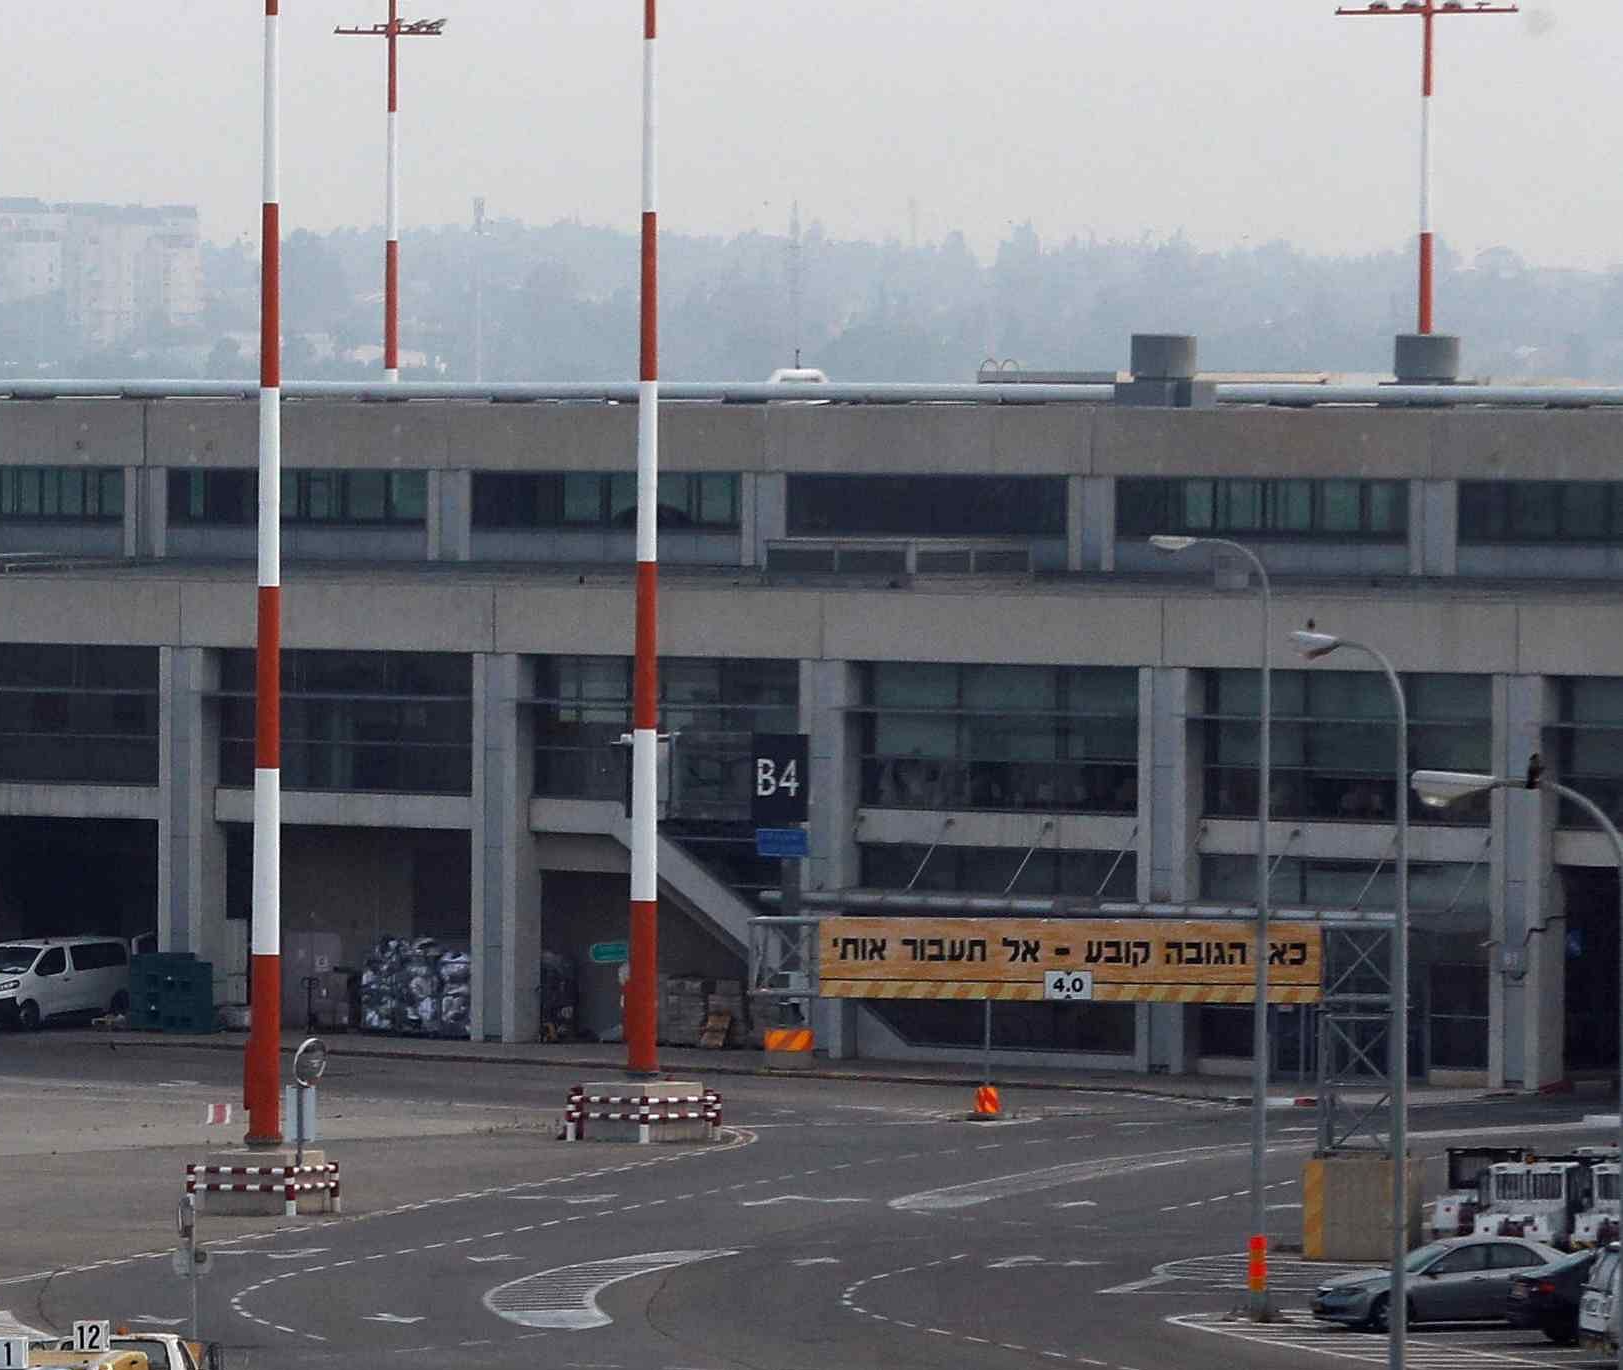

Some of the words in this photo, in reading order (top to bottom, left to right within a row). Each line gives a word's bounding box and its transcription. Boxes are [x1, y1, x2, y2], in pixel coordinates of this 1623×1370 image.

[756, 758, 800, 797] B4
[832, 937, 888, 961] אותי
[900, 938, 988, 962] תעבור
[1001, 937, 1041, 962] אל
[1085, 940, 1151, 968] קובע
[1164, 942, 1248, 965] הגובה
[1267, 942, 1308, 966] כא
[1053, 977, 1084, 993] 4.0
[77, 1324, 101, 1351] 12
[3, 1342, 12, 1367] 1
